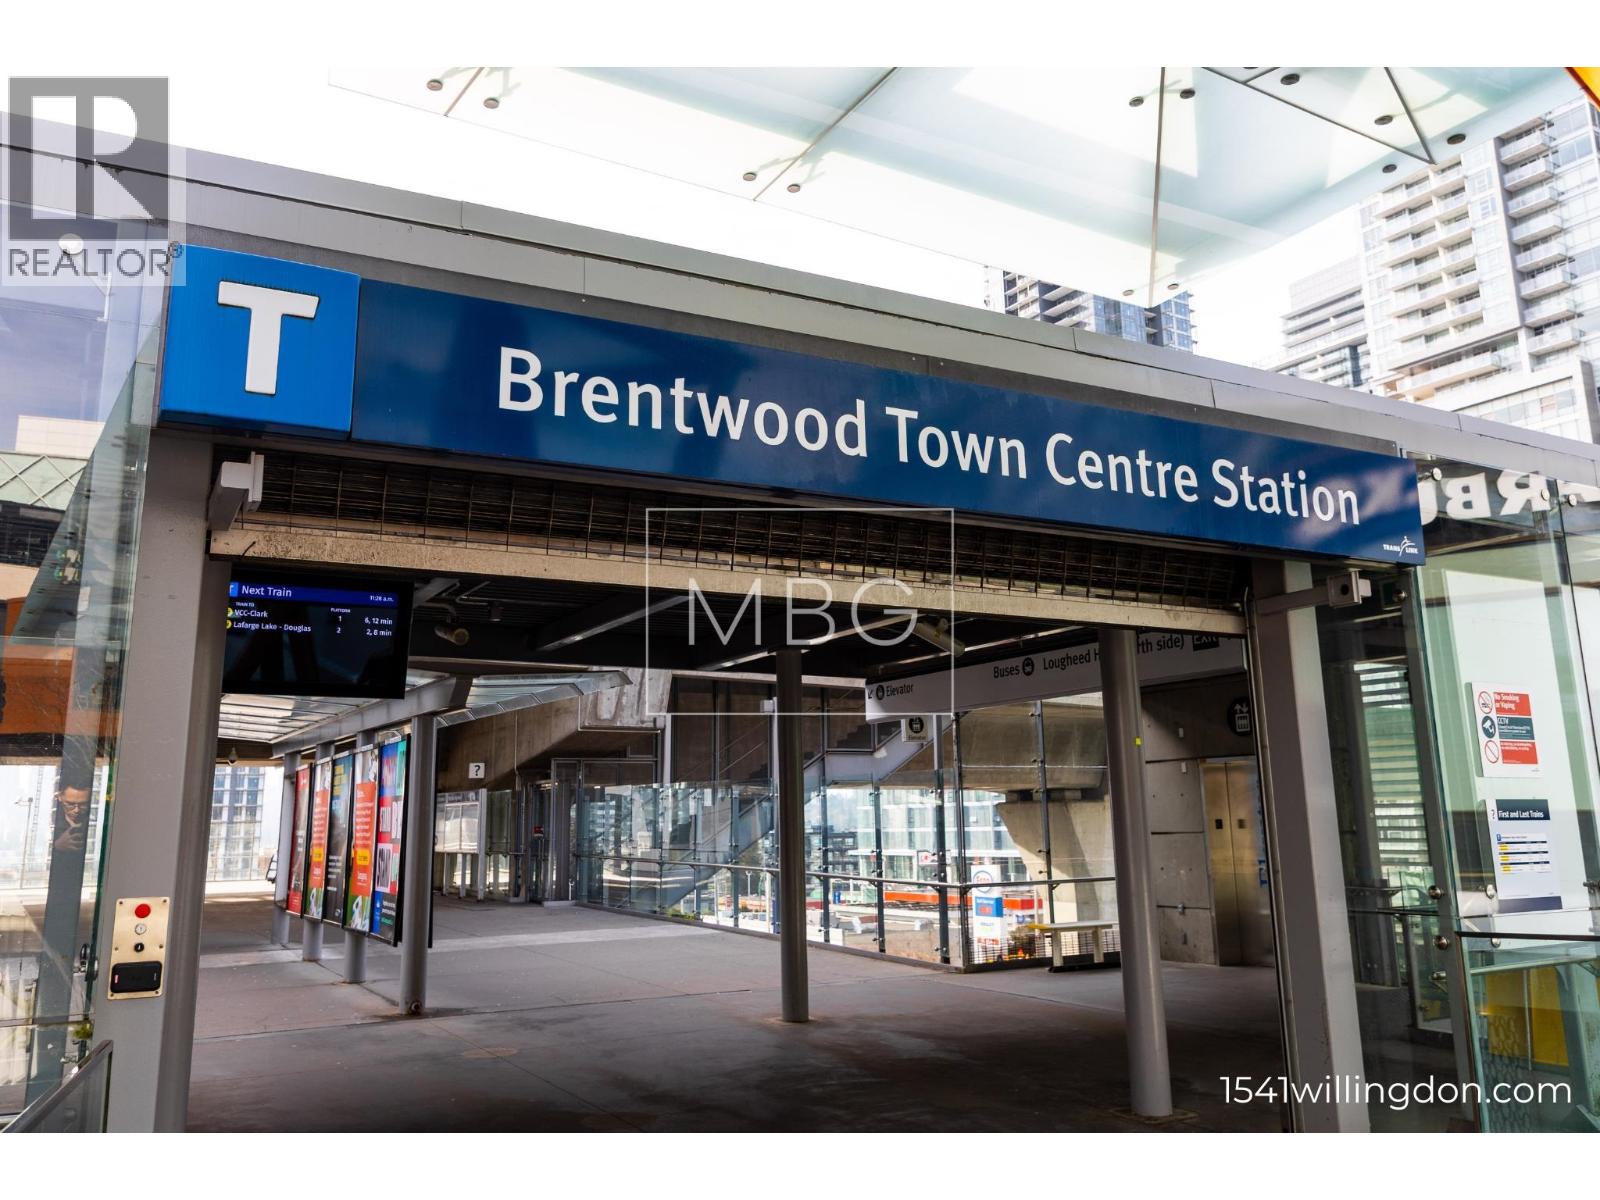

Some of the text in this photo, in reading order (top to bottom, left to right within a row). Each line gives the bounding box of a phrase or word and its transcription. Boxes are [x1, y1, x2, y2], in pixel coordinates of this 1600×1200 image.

[217, 281, 319, 394] T
[498, 346, 1361, 525] Brentwood Town Centre Station
[241, 585, 292, 598] Next Train
[234, 609, 269, 619] VCC-Clark
[380, 617, 393, 625] min
[233, 621, 260, 631] Lafarge
[261, 622, 278, 630] Lake
[283, 623, 312, 633] Douglas
[379, 628, 392, 636] min
[1043, 649, 1091, 671] Lougheed
[1156, 633, 1185, 652] side)
[993, 664, 1020, 679] Buses
[886, 683, 914, 697] Elevator
[1501, 694, 1520, 703] Smoking
[1501, 702, 1516, 711] Vaping
[1498, 717, 1509, 725] CCTV
[1498, 810, 1544, 819] First and Last Trains
